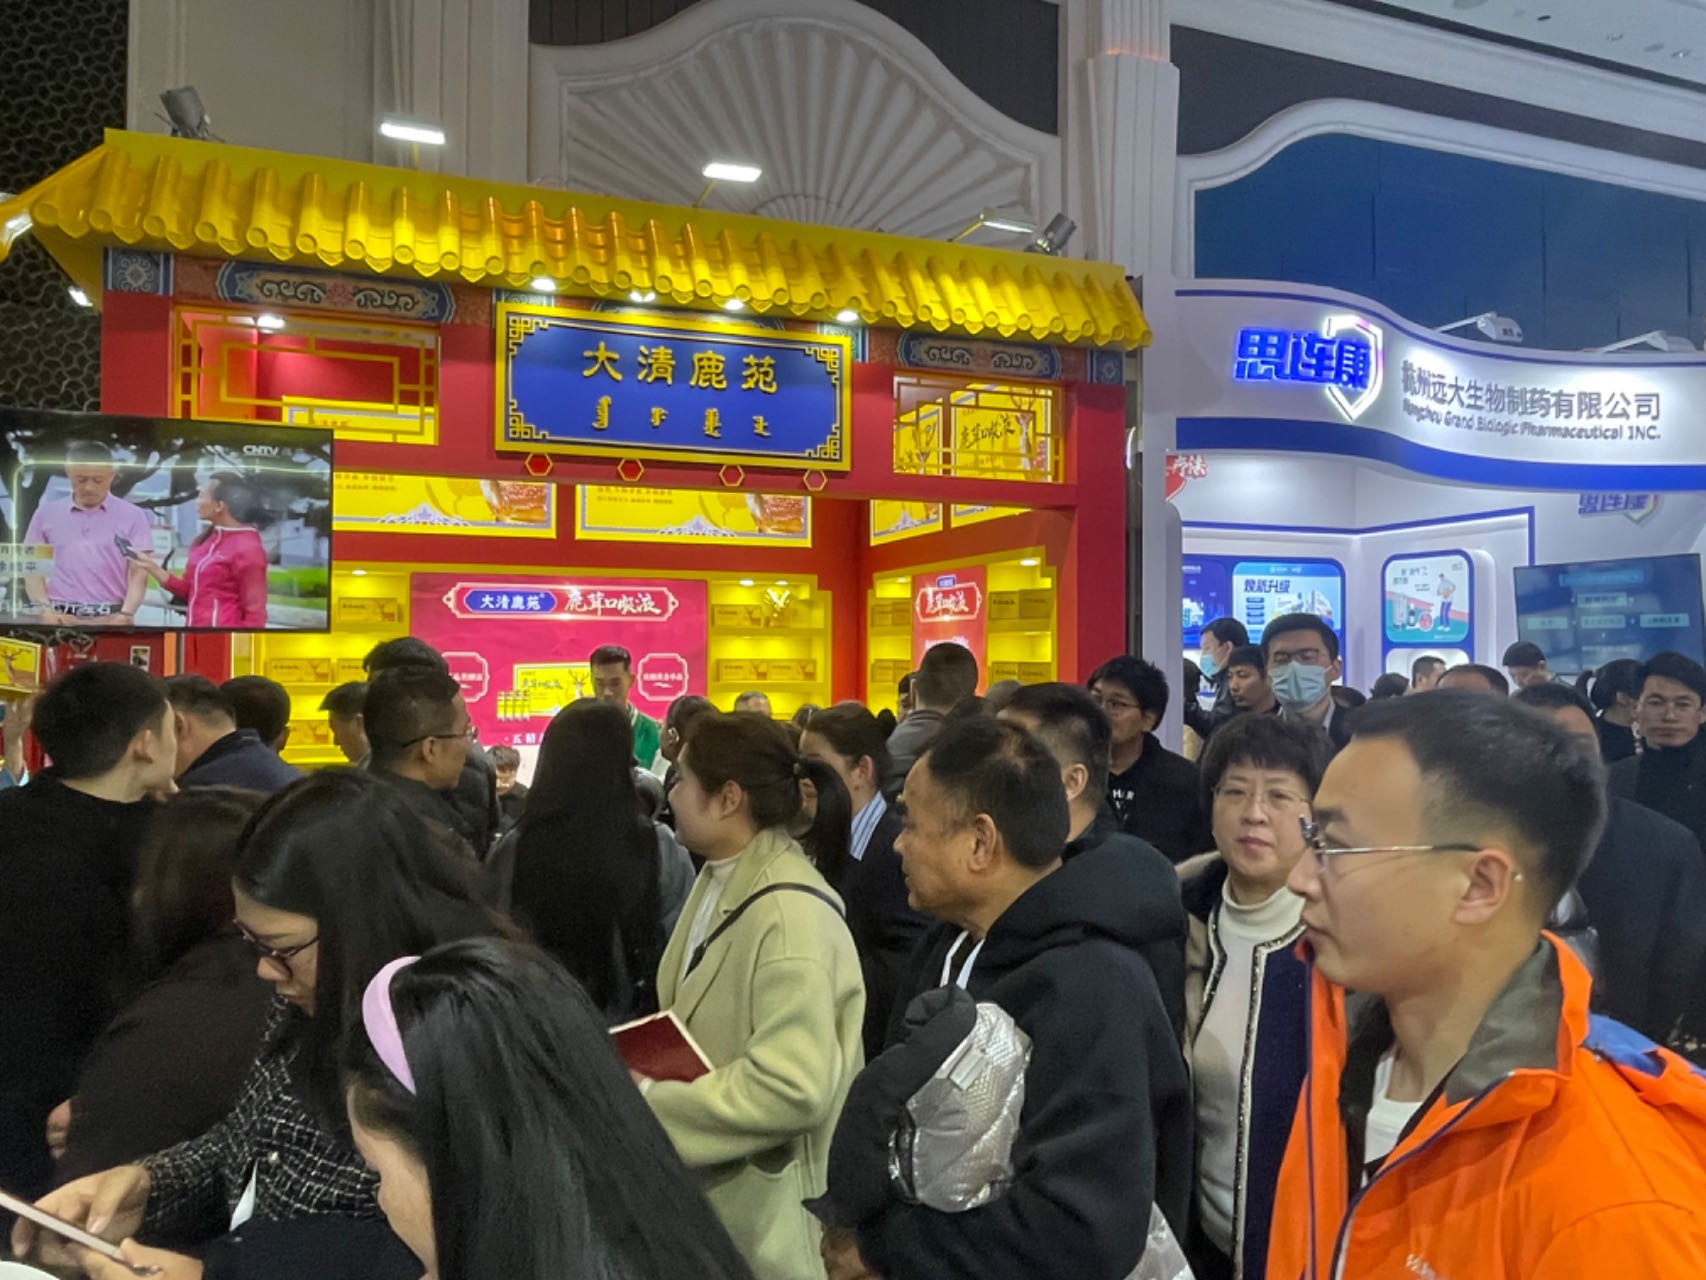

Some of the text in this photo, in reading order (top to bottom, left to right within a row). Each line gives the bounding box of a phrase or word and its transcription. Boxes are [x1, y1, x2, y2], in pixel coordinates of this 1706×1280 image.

[582, 341, 778, 394] 大清鹿苑
[1235, 329, 1371, 389] 思连康
[1401, 359, 1661, 421] 杭州远大生物制药有限公司
[1444, 411, 1474, 430] Grand
[1477, 416, 1518, 436] Biologic
[1520, 421, 1624, 440] Pharmaceutical
[1628, 424, 1661, 440] INC.
